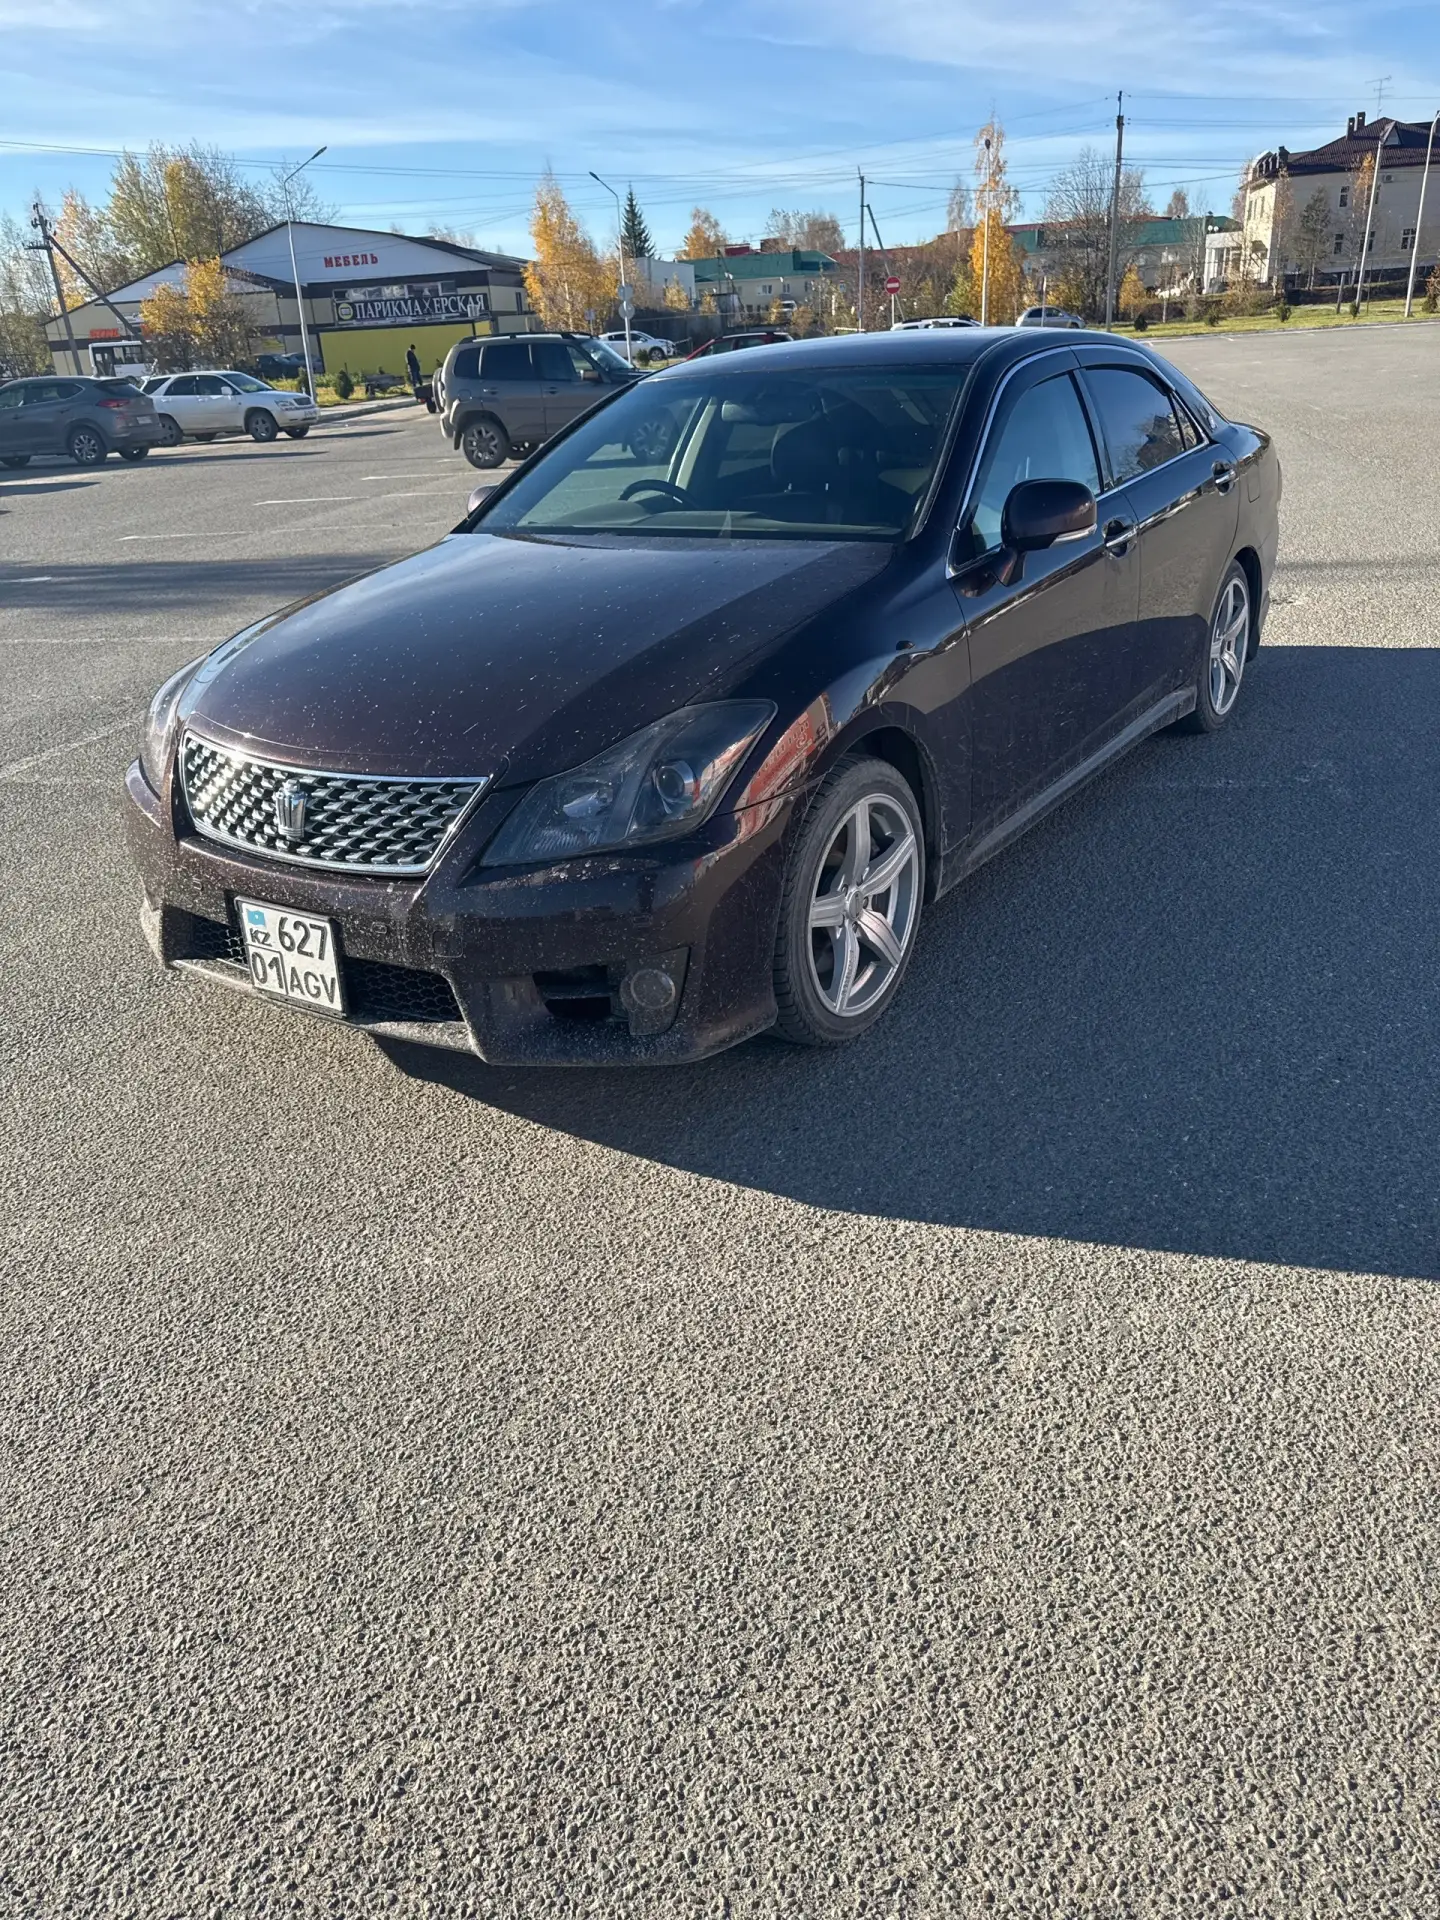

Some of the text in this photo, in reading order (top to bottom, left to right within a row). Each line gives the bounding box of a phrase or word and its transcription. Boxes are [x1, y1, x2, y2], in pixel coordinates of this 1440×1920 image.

[323, 253, 379, 268] МЕБЕЛЬ
[354, 294, 485, 319] ПАРИКМАХЕРСКАЯ
[249, 928, 273, 947] KZ
[278, 916, 328, 961] 627
[251, 951, 336, 1004] 01 AGV
